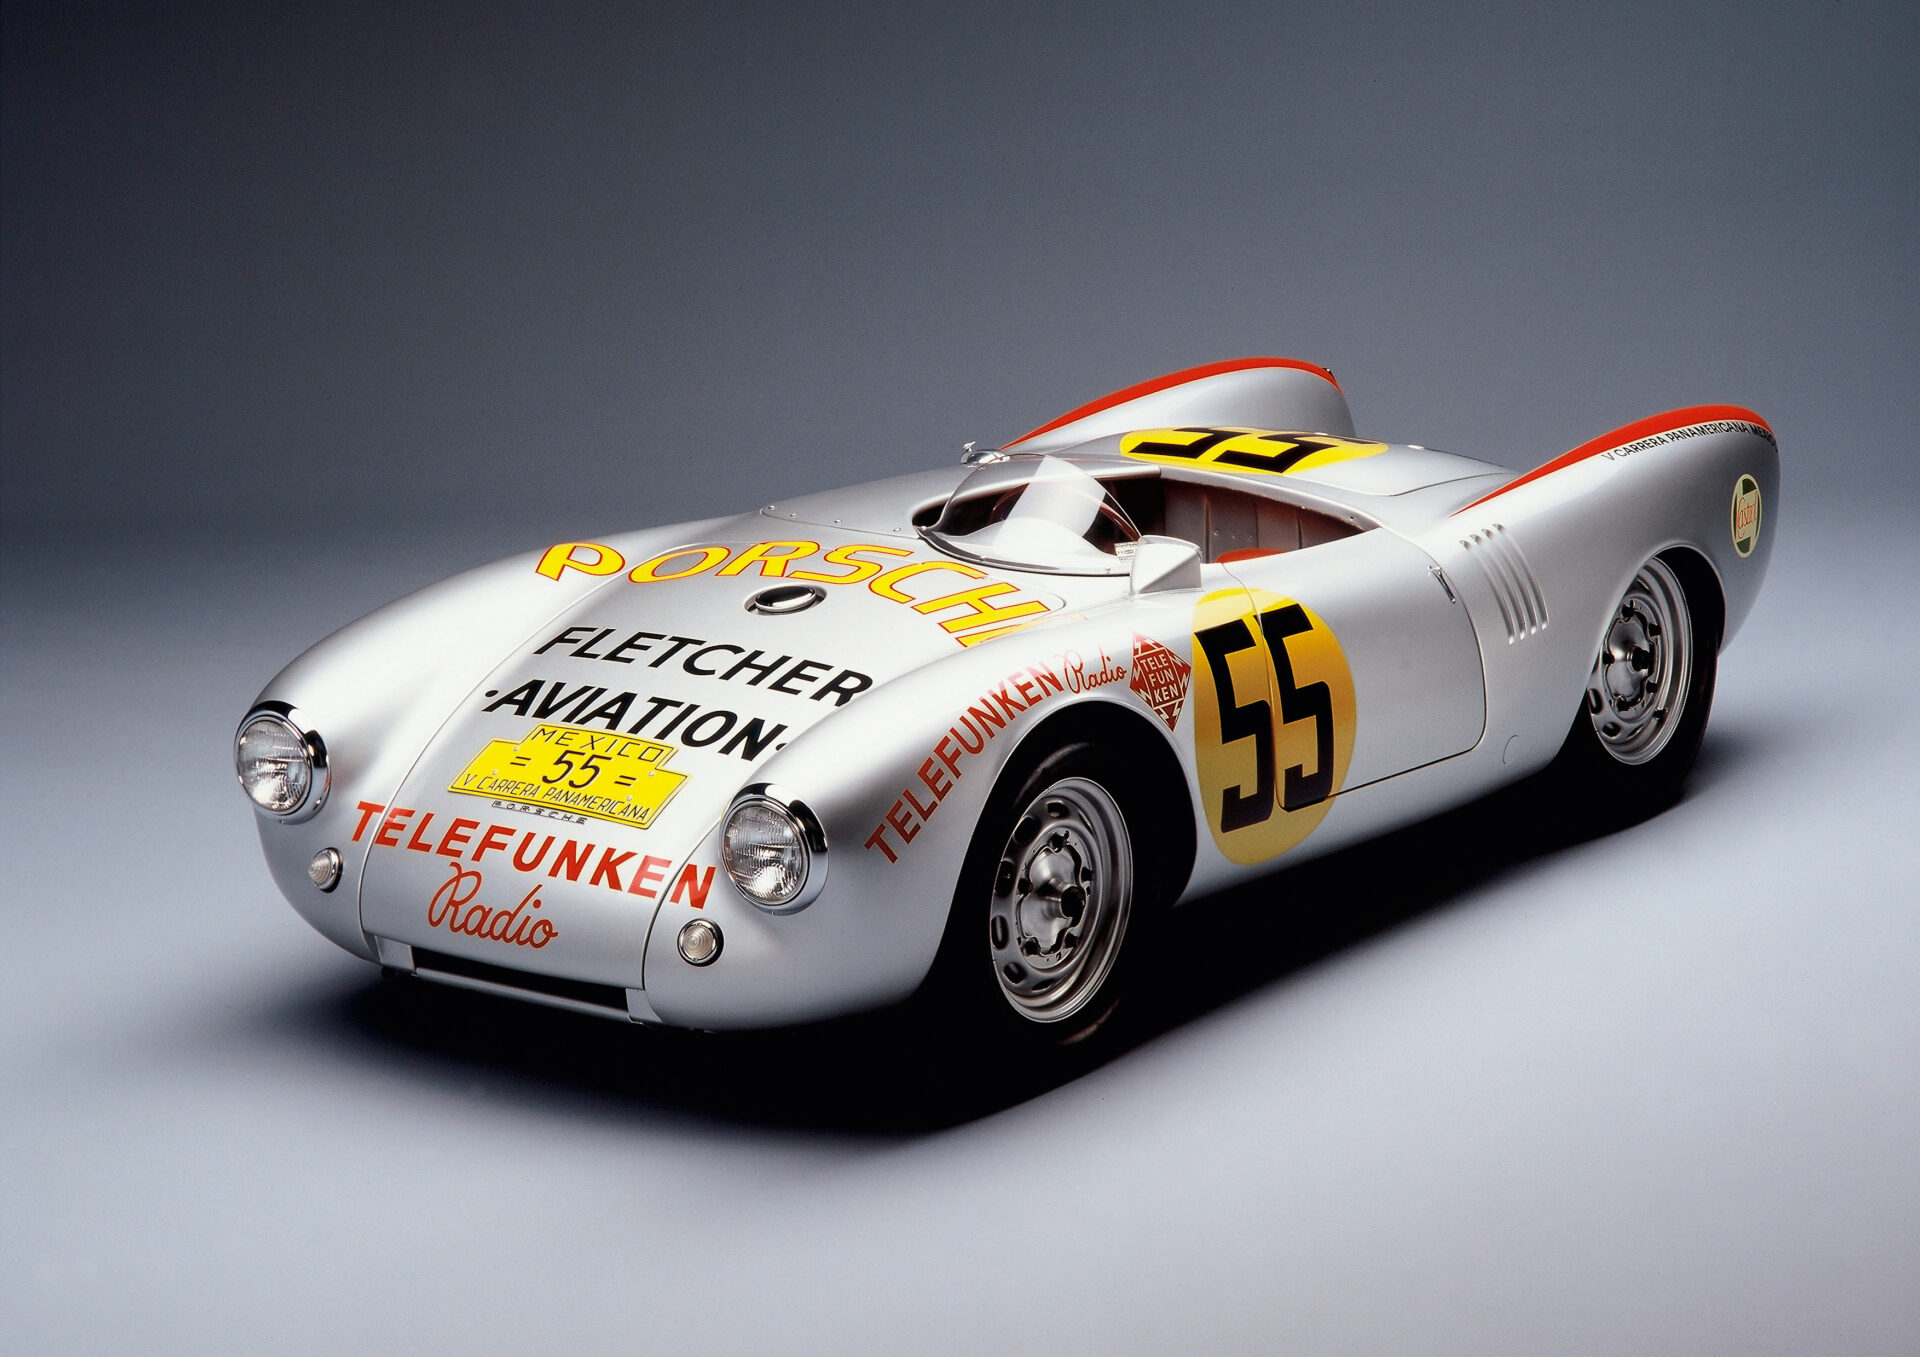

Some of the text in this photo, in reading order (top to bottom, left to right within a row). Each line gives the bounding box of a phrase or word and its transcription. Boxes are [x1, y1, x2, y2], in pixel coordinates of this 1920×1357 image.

[1601, 452, 1615, 461] V
[1613, 435, 1669, 458] CARRERA
[1665, 421, 1750, 443] PANAMERICANA
[532, 626, 873, 707] FLETCHER
[1140, 653, 1169, 672] TELE
[1148, 669, 1174, 687] FUN
[1153, 685, 1179, 703] KEN
[1194, 603, 1335, 833] 55
[531, 728, 665, 764] MEXICO
[863, 644, 1127, 865] TELEFUNKEN Radio
[541, 749, 612, 789] 55
[463, 773, 651, 821] V CARRERA PANAMERICANA
[491, 800, 588, 825] PORSCHE
[351, 800, 717, 910] TELEFUNKEN
[426, 862, 559, 950] Radio
